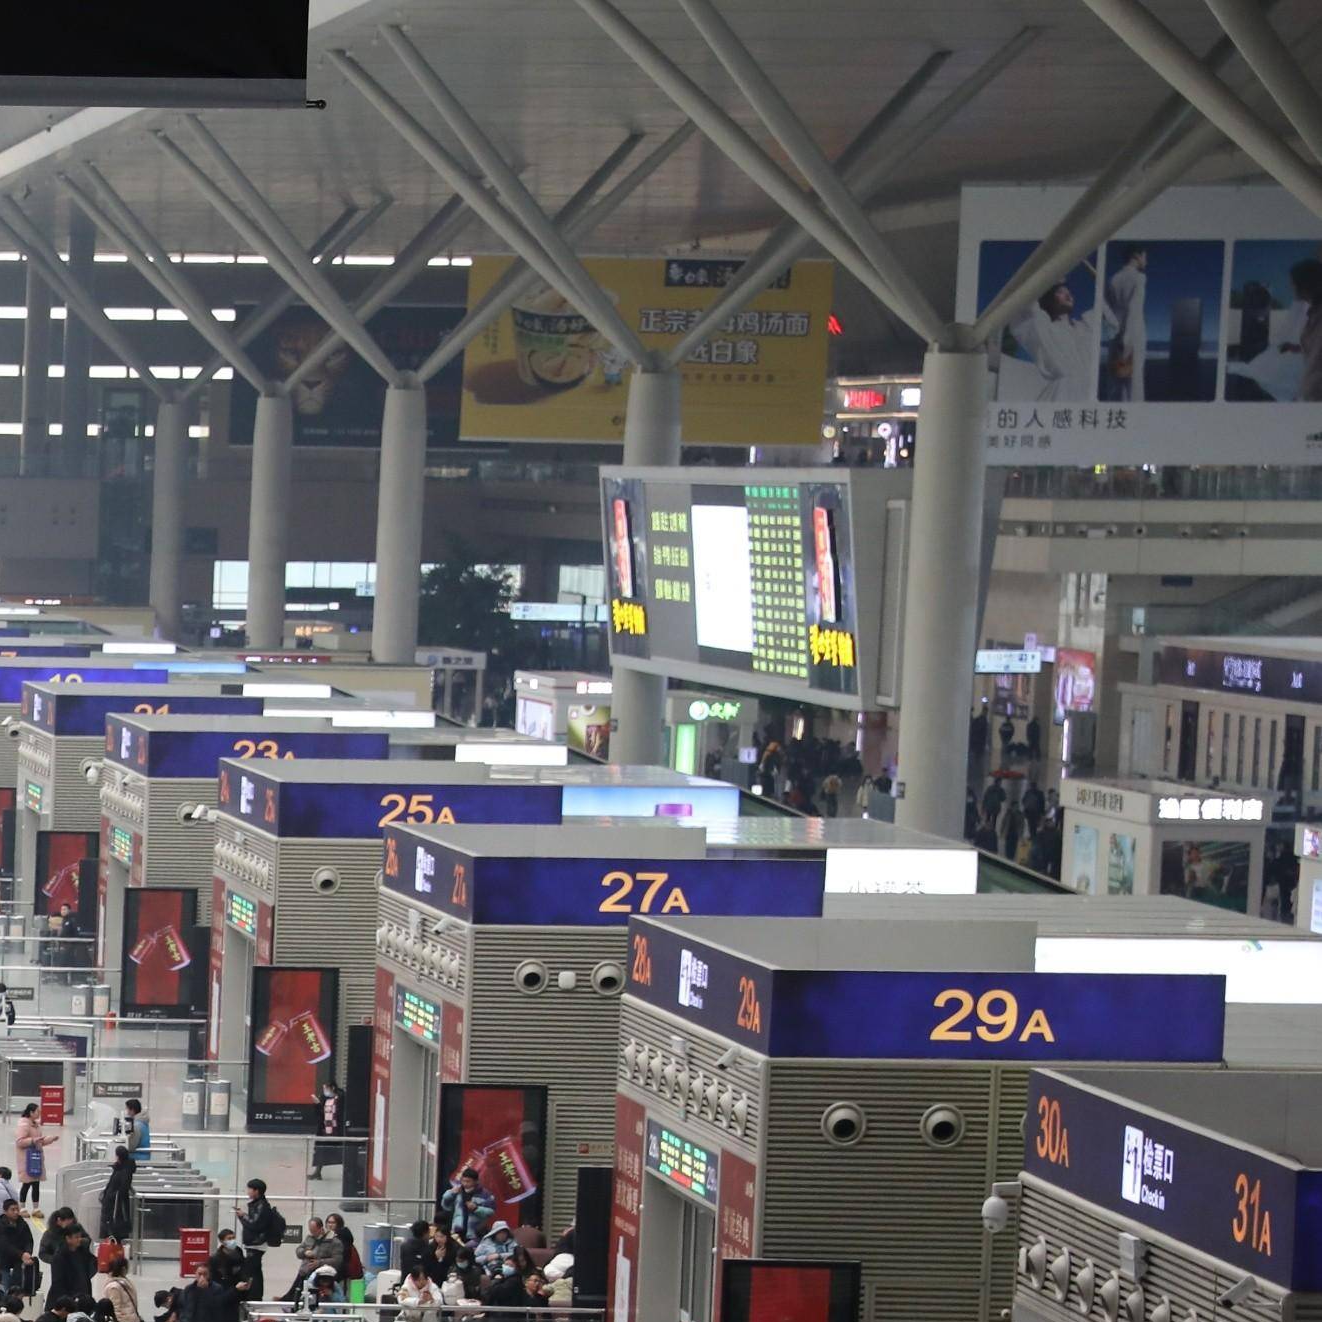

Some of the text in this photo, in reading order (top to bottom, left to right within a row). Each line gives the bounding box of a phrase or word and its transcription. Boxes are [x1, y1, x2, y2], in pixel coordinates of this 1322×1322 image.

[377, 793, 457, 825] 25A
[598, 870, 691, 915] 27A
[631, 933, 651, 988] 28A
[736, 975, 761, 1034] 29A
[929, 988, 1055, 1043] 29A
[1035, 1095, 1070, 1169] 30A
[1142, 1137, 1175, 1184] 检票口
[1231, 1173, 1272, 1258] 31A
